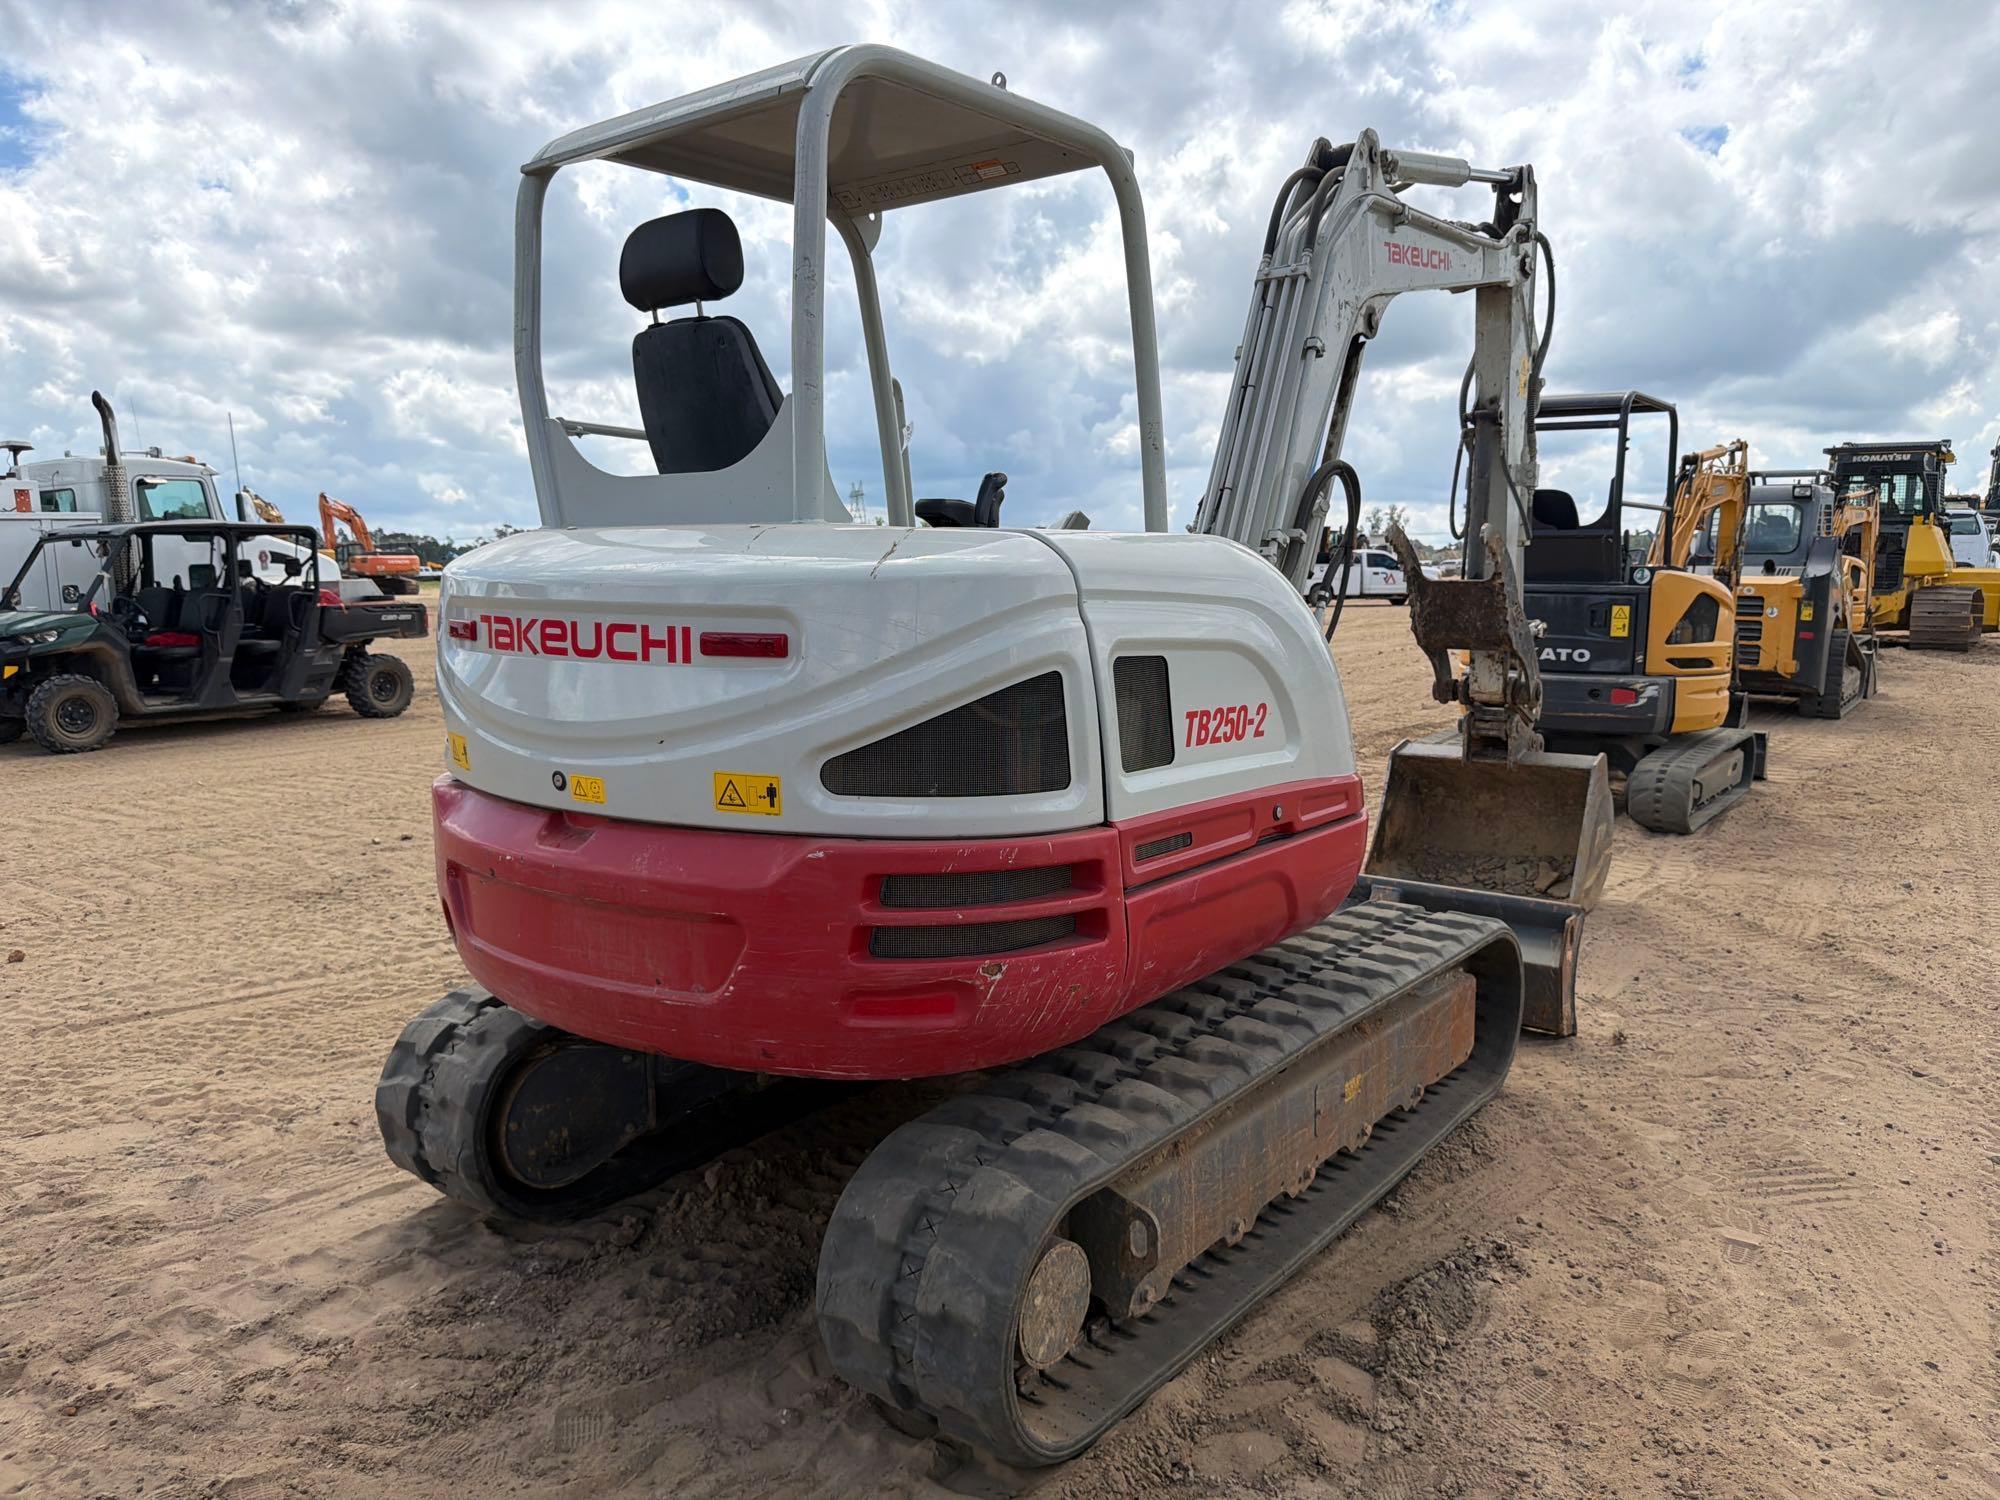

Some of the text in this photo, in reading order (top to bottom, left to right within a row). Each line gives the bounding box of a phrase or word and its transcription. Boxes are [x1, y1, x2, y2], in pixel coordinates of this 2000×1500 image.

[1852, 453, 1911, 463] KOMATSU
[1534, 647, 1591, 663] ATO
[1185, 702, 1267, 748] TB250-2
